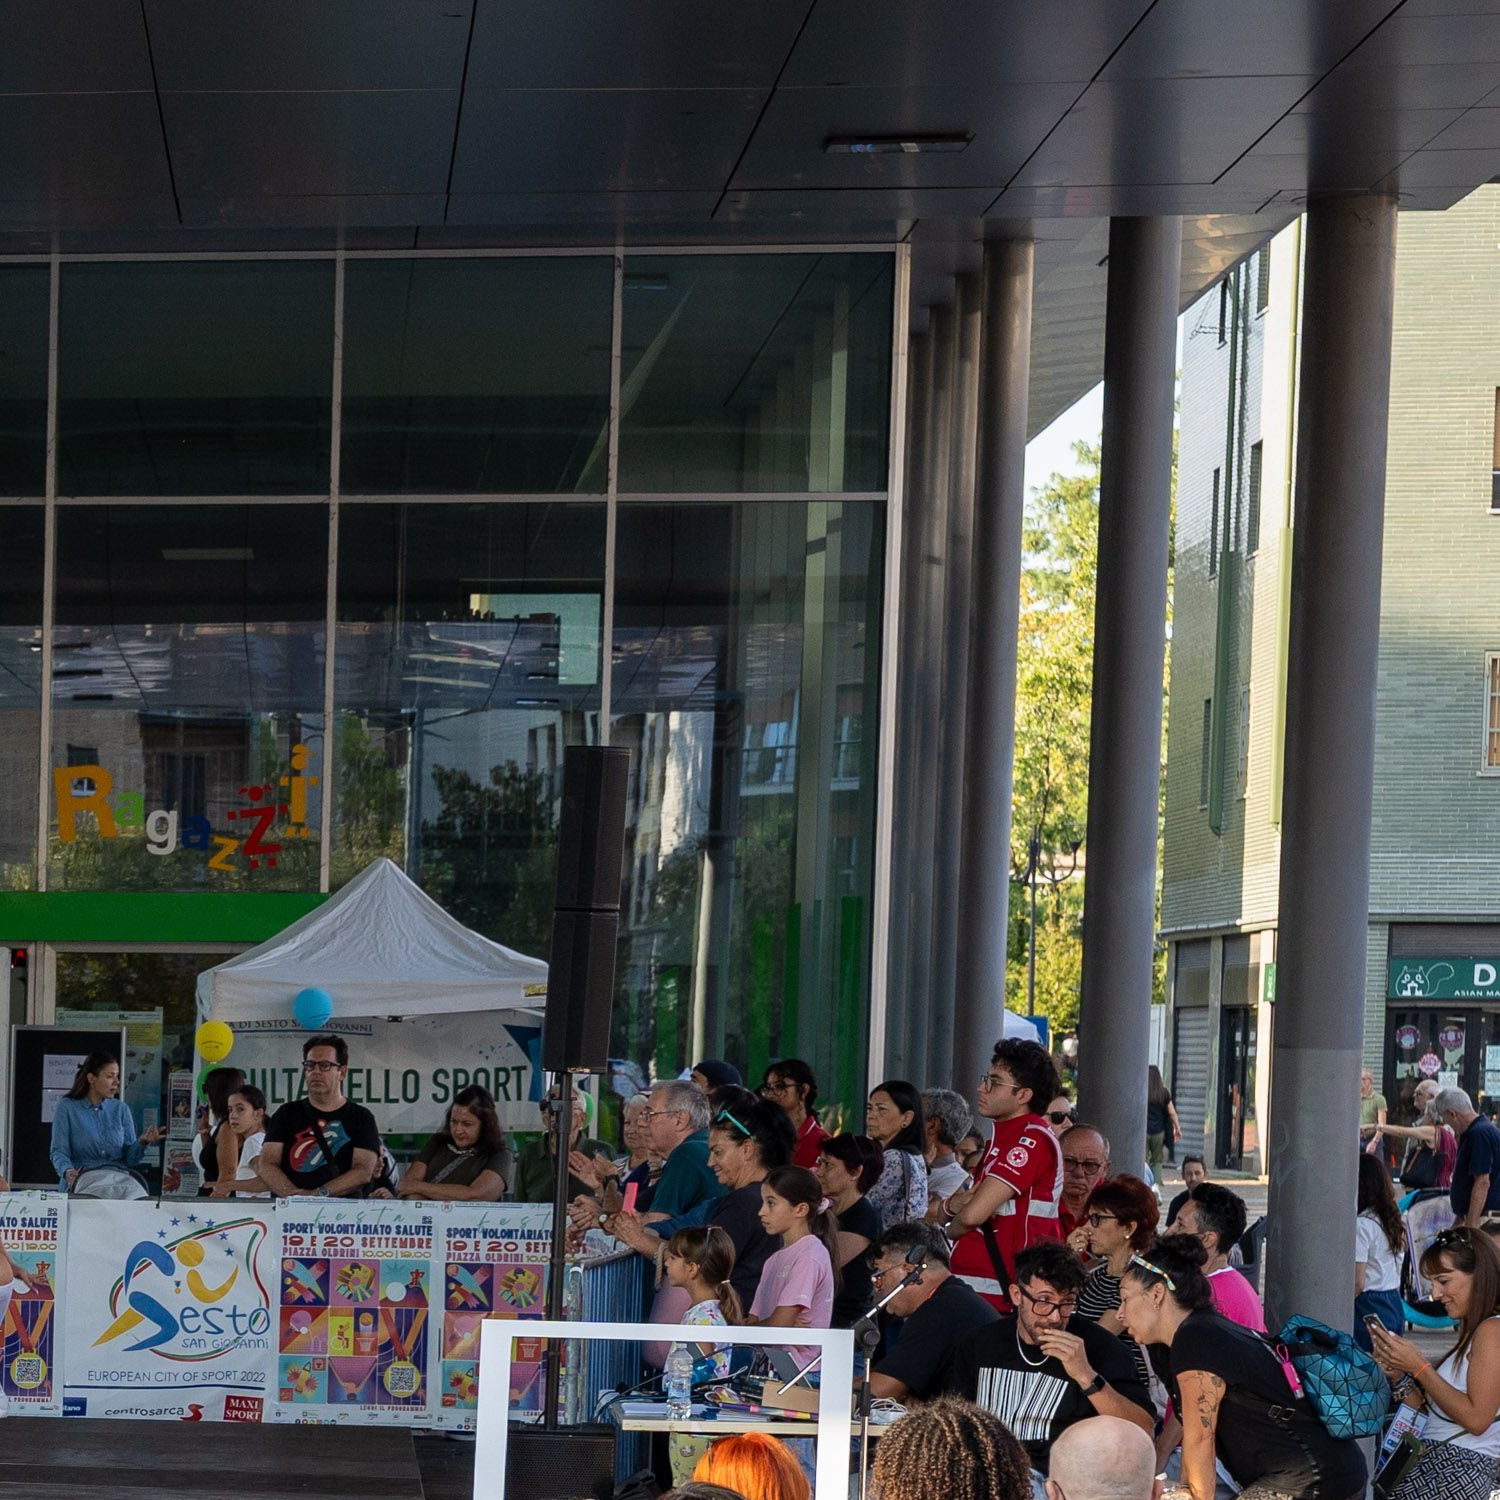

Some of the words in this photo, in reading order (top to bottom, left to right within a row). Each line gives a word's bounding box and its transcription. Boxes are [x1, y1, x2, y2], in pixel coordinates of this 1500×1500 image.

[53, 744, 320, 873] Ragazzi
[20, 1217, 58, 1228] SALUTE
[281, 1223, 314, 1234] SPORT
[317, 1223, 392, 1235] VOLONTARIATO
[394, 1224, 433, 1236] SALUTE
[445, 1227, 478, 1240] SPORT
[281, 1235, 304, 1247] 19
[310, 1235, 317, 1247] E
[323, 1236, 355, 1248] 20
[360, 1237, 433, 1249] SETTEMBRE
[445, 1240, 468, 1252] 19
[474, 1240, 481, 1252] E
[487, 1240, 519, 1253] 20
[282, 1247, 317, 1257] PIAZZA
[321, 1248, 360, 1258] OLDRINI
[446, 1252, 481, 1262] PIAZZA
[485, 1252, 524, 1262] OLDRINI
[87, 1370, 150, 1383] EUROPEAN
[155, 1370, 178, 1383] CITY
[182, 1371, 199, 1383] OF
[201, 1370, 238, 1382] SPORT
[240, 1371, 266, 1384] 2022
[229, 1398, 259, 1409] MAXI
[104, 1406, 184, 1417] centrosarca
[225, 1409, 261, 1421] SPORT
